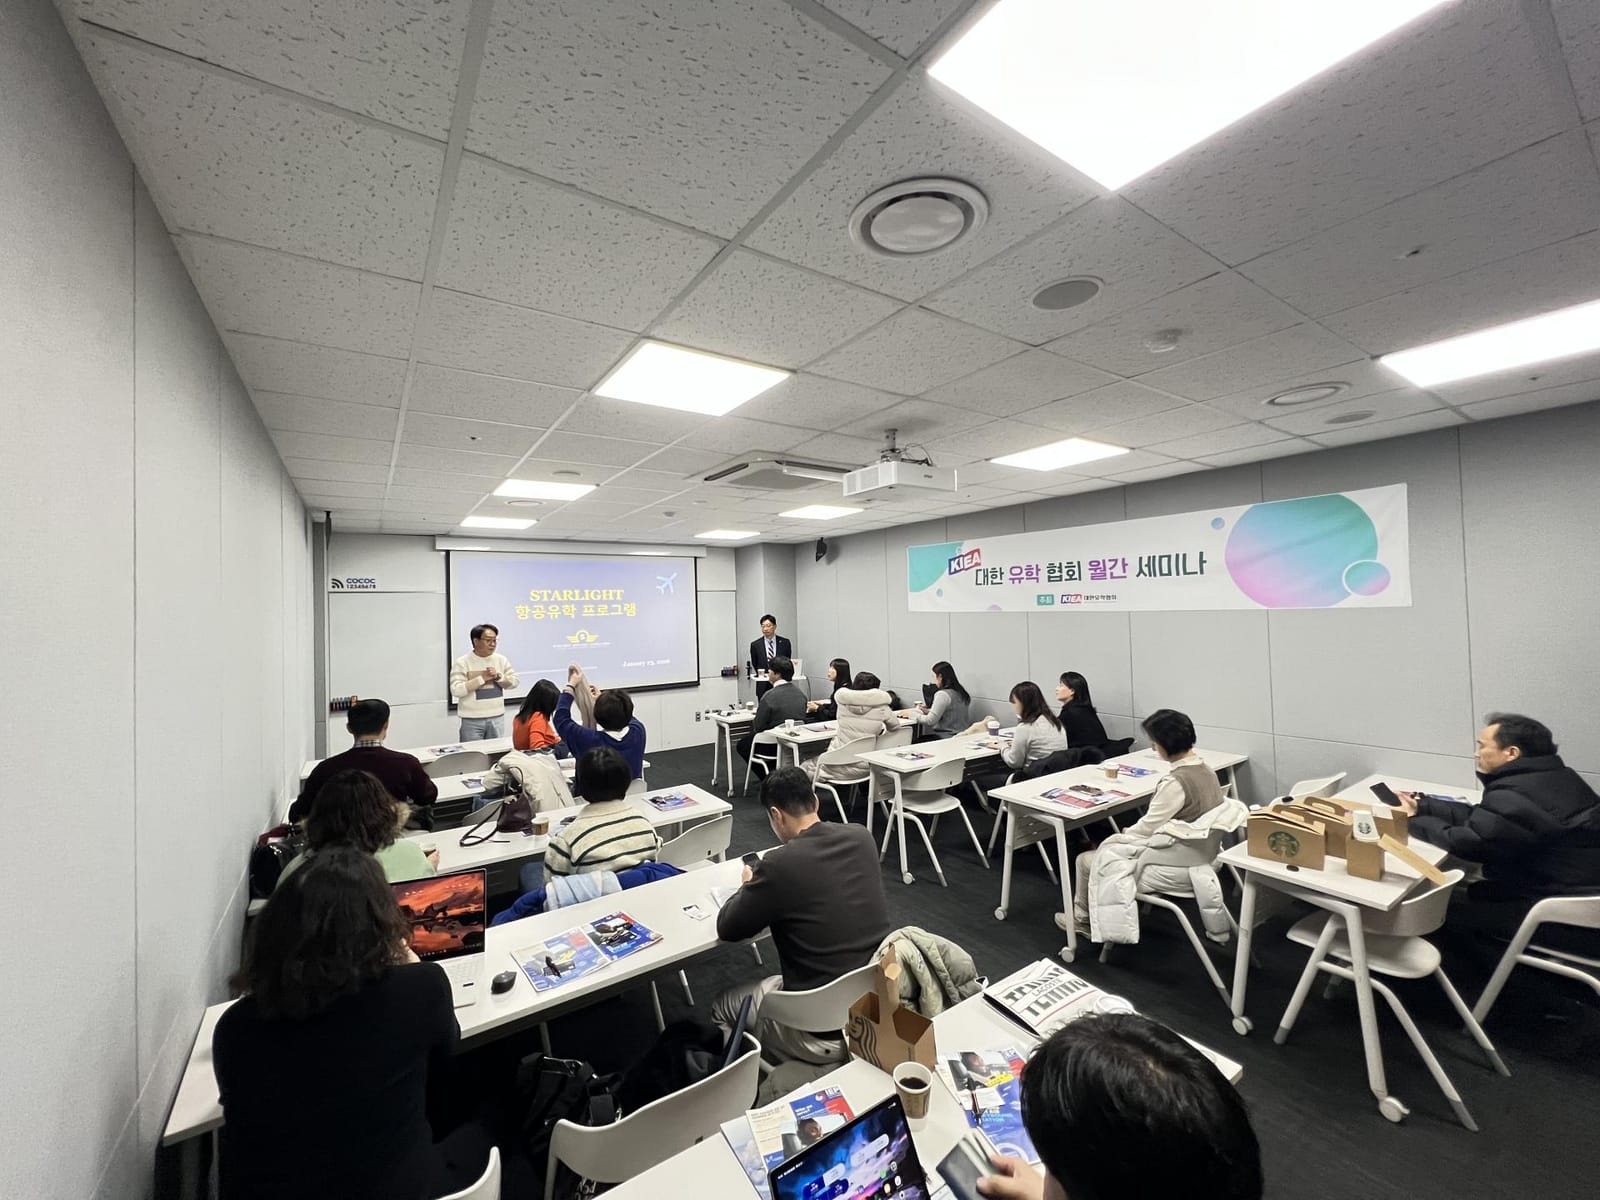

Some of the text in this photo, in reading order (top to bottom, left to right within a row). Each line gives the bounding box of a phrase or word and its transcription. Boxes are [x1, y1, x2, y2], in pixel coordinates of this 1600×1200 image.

[950, 550, 981, 574] KIEA
[975, 552, 1207, 585] 대한 유학 협회 월간 세미나
[529, 589, 624, 601] STARLIGHT
[515, 602, 637, 620] 항공유학 프로그램
